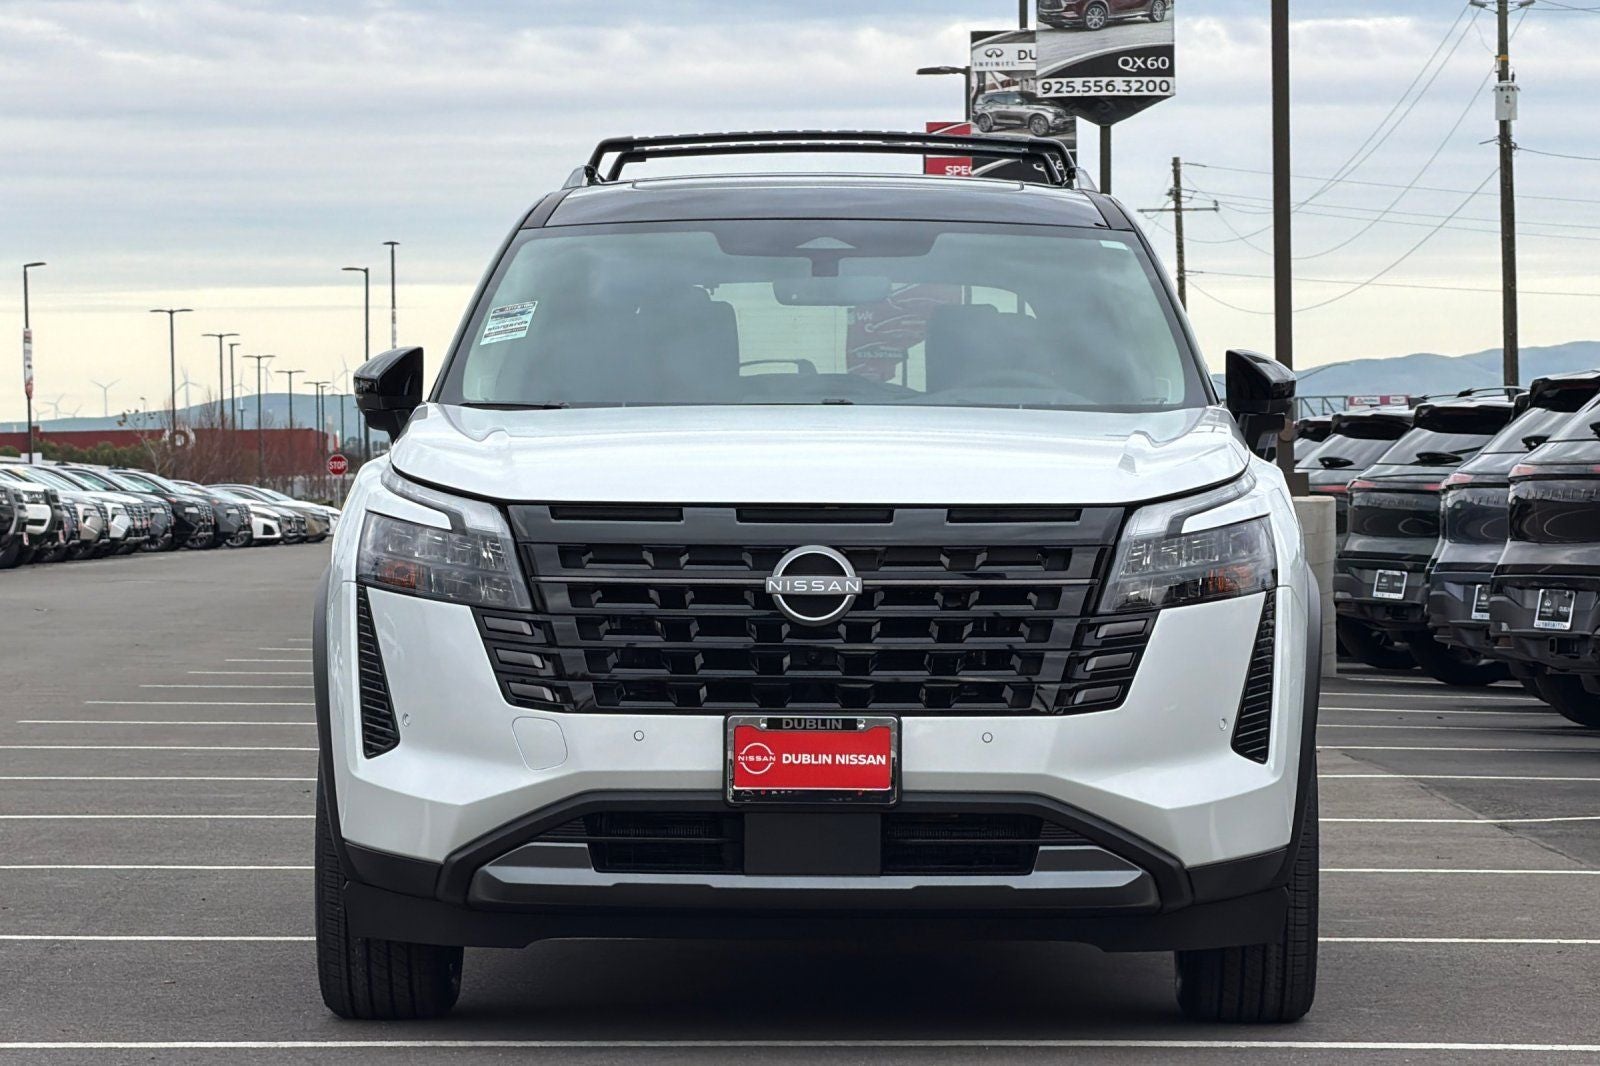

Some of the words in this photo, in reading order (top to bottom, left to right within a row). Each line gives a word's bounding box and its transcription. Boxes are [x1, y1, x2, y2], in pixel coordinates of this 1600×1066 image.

[1117, 56, 1170, 72] QX60
[1041, 79, 1171, 95] 925.556.3200
[329, 461, 346, 470] STOP
[768, 580, 860, 592] NISSAN
[782, 718, 843, 730] DUBLIN
[782, 753, 832, 765] DUBLIN
[836, 754, 886, 766] NISSAN
